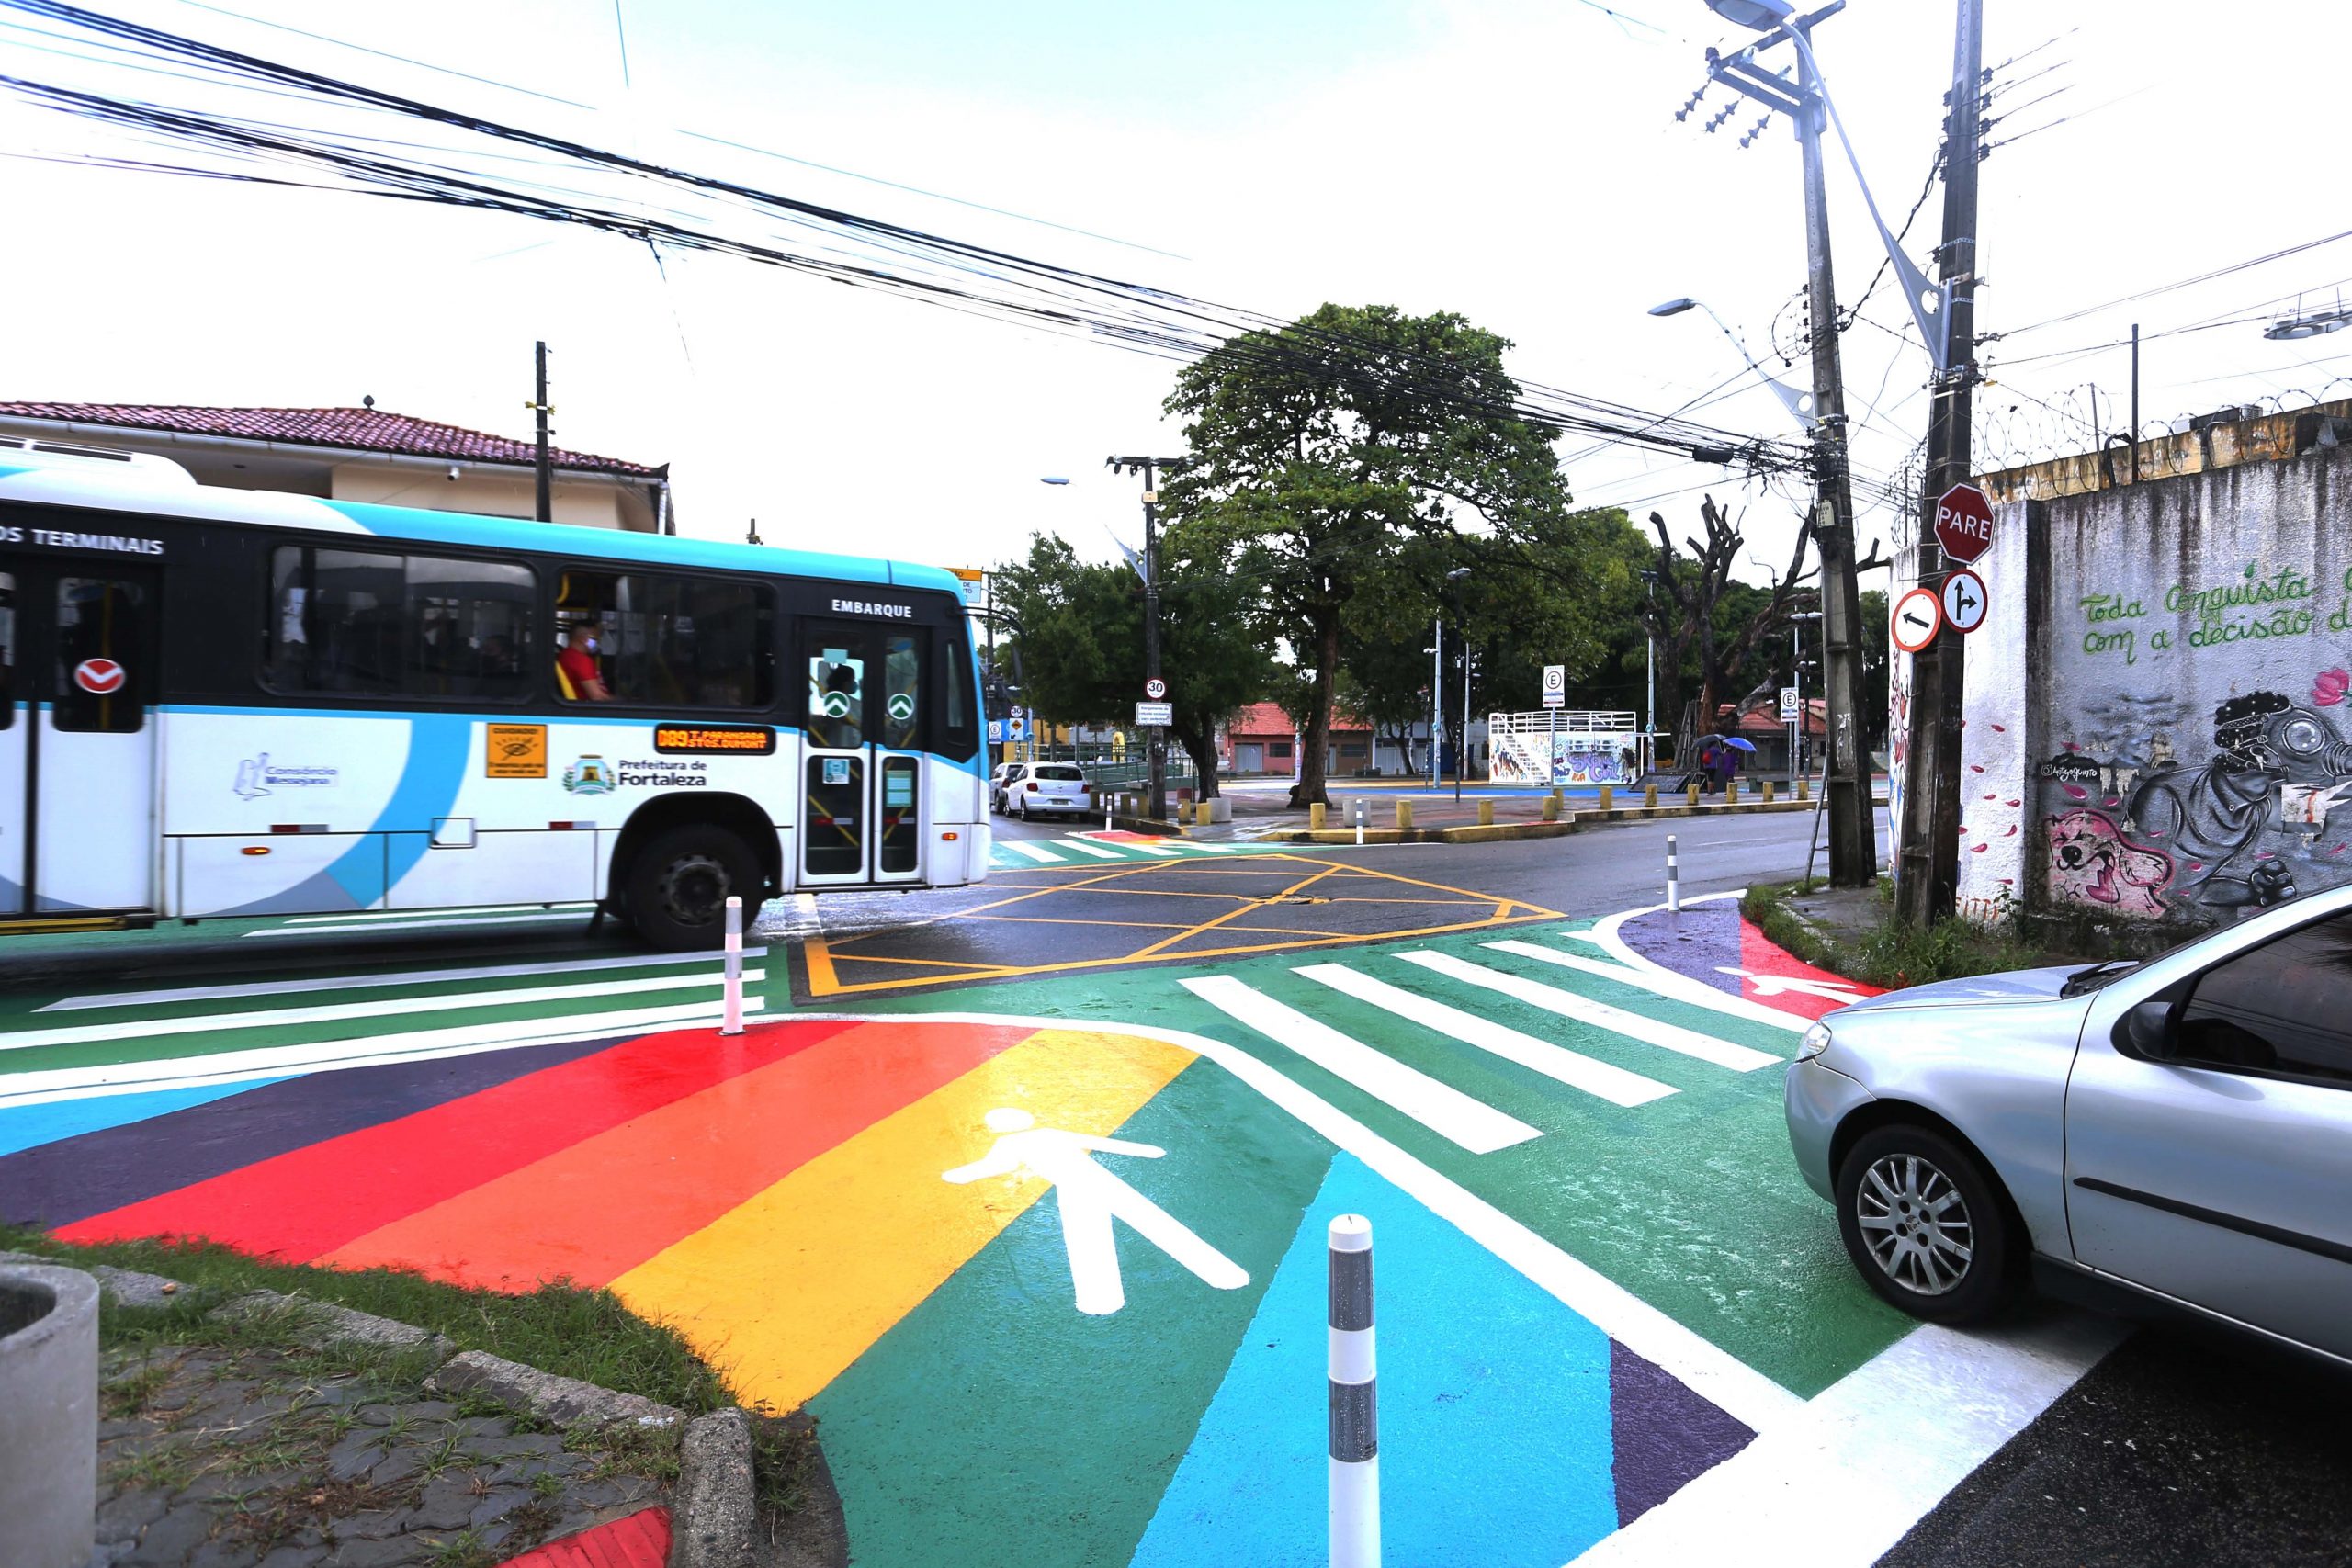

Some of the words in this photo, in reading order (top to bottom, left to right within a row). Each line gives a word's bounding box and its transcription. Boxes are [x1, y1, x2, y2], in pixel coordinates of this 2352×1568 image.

[1938, 506, 1992, 541] PARE
[30, 528, 164, 555] TERMINAIS
[831, 599, 912, 618] EMBARQUE
[2150, 629, 2174, 650] a
[2188, 609, 2315, 648] decisão
[1148, 682, 1163, 692] 30
[618, 760, 687, 771] Prefeitura
[690, 761, 707, 771] de
[618, 772, 707, 787] Fortaleza
